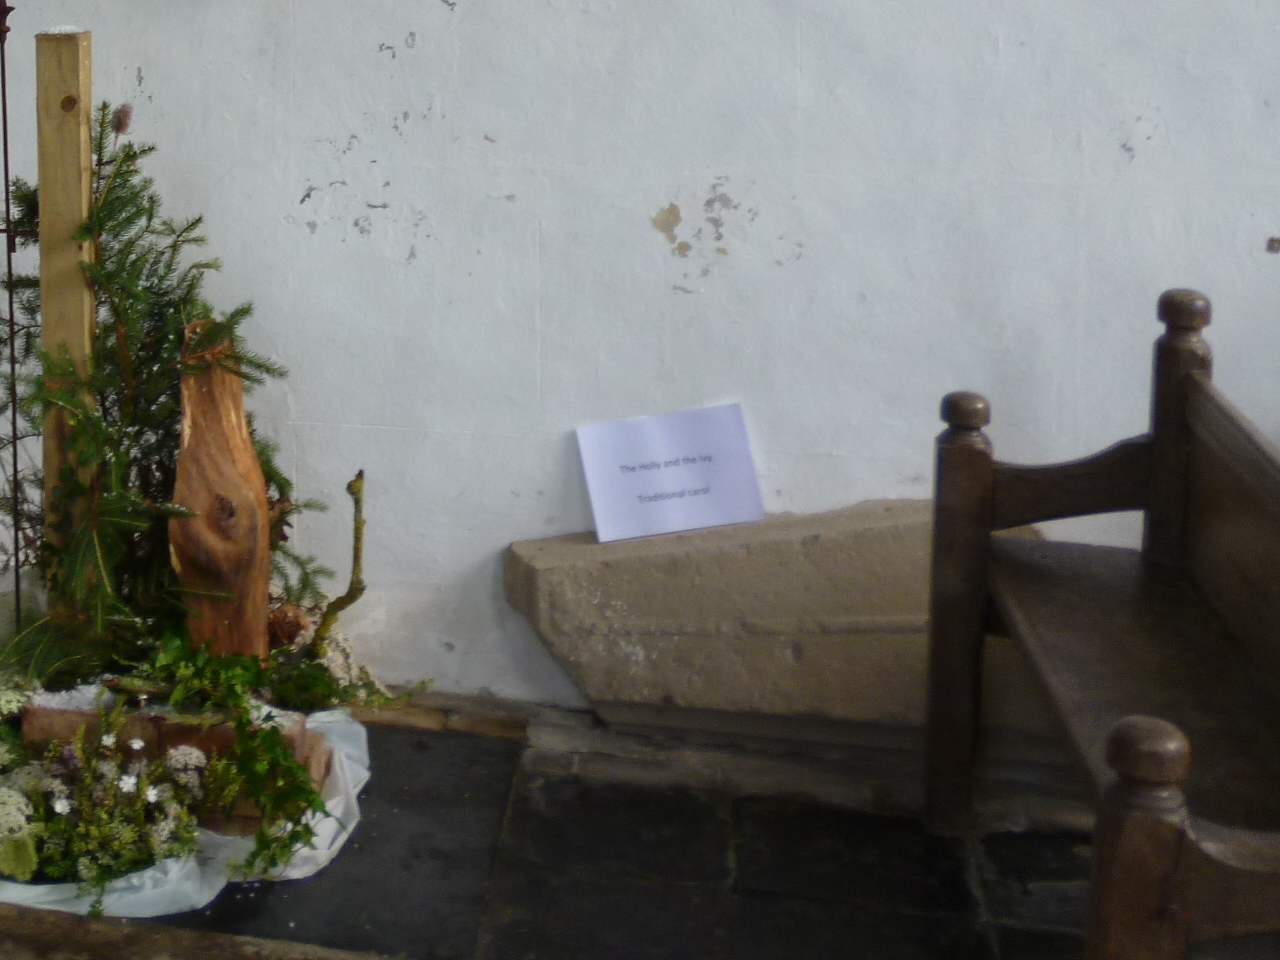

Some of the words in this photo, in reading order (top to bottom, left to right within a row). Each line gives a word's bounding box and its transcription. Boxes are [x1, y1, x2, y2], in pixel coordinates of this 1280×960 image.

[619, 465, 637, 474] The
[638, 461, 661, 471] Holly
[663, 458, 680, 468] and
[681, 455, 697, 464] the
[637, 489, 686, 502] Traditional
[687, 486, 710, 497] carol
